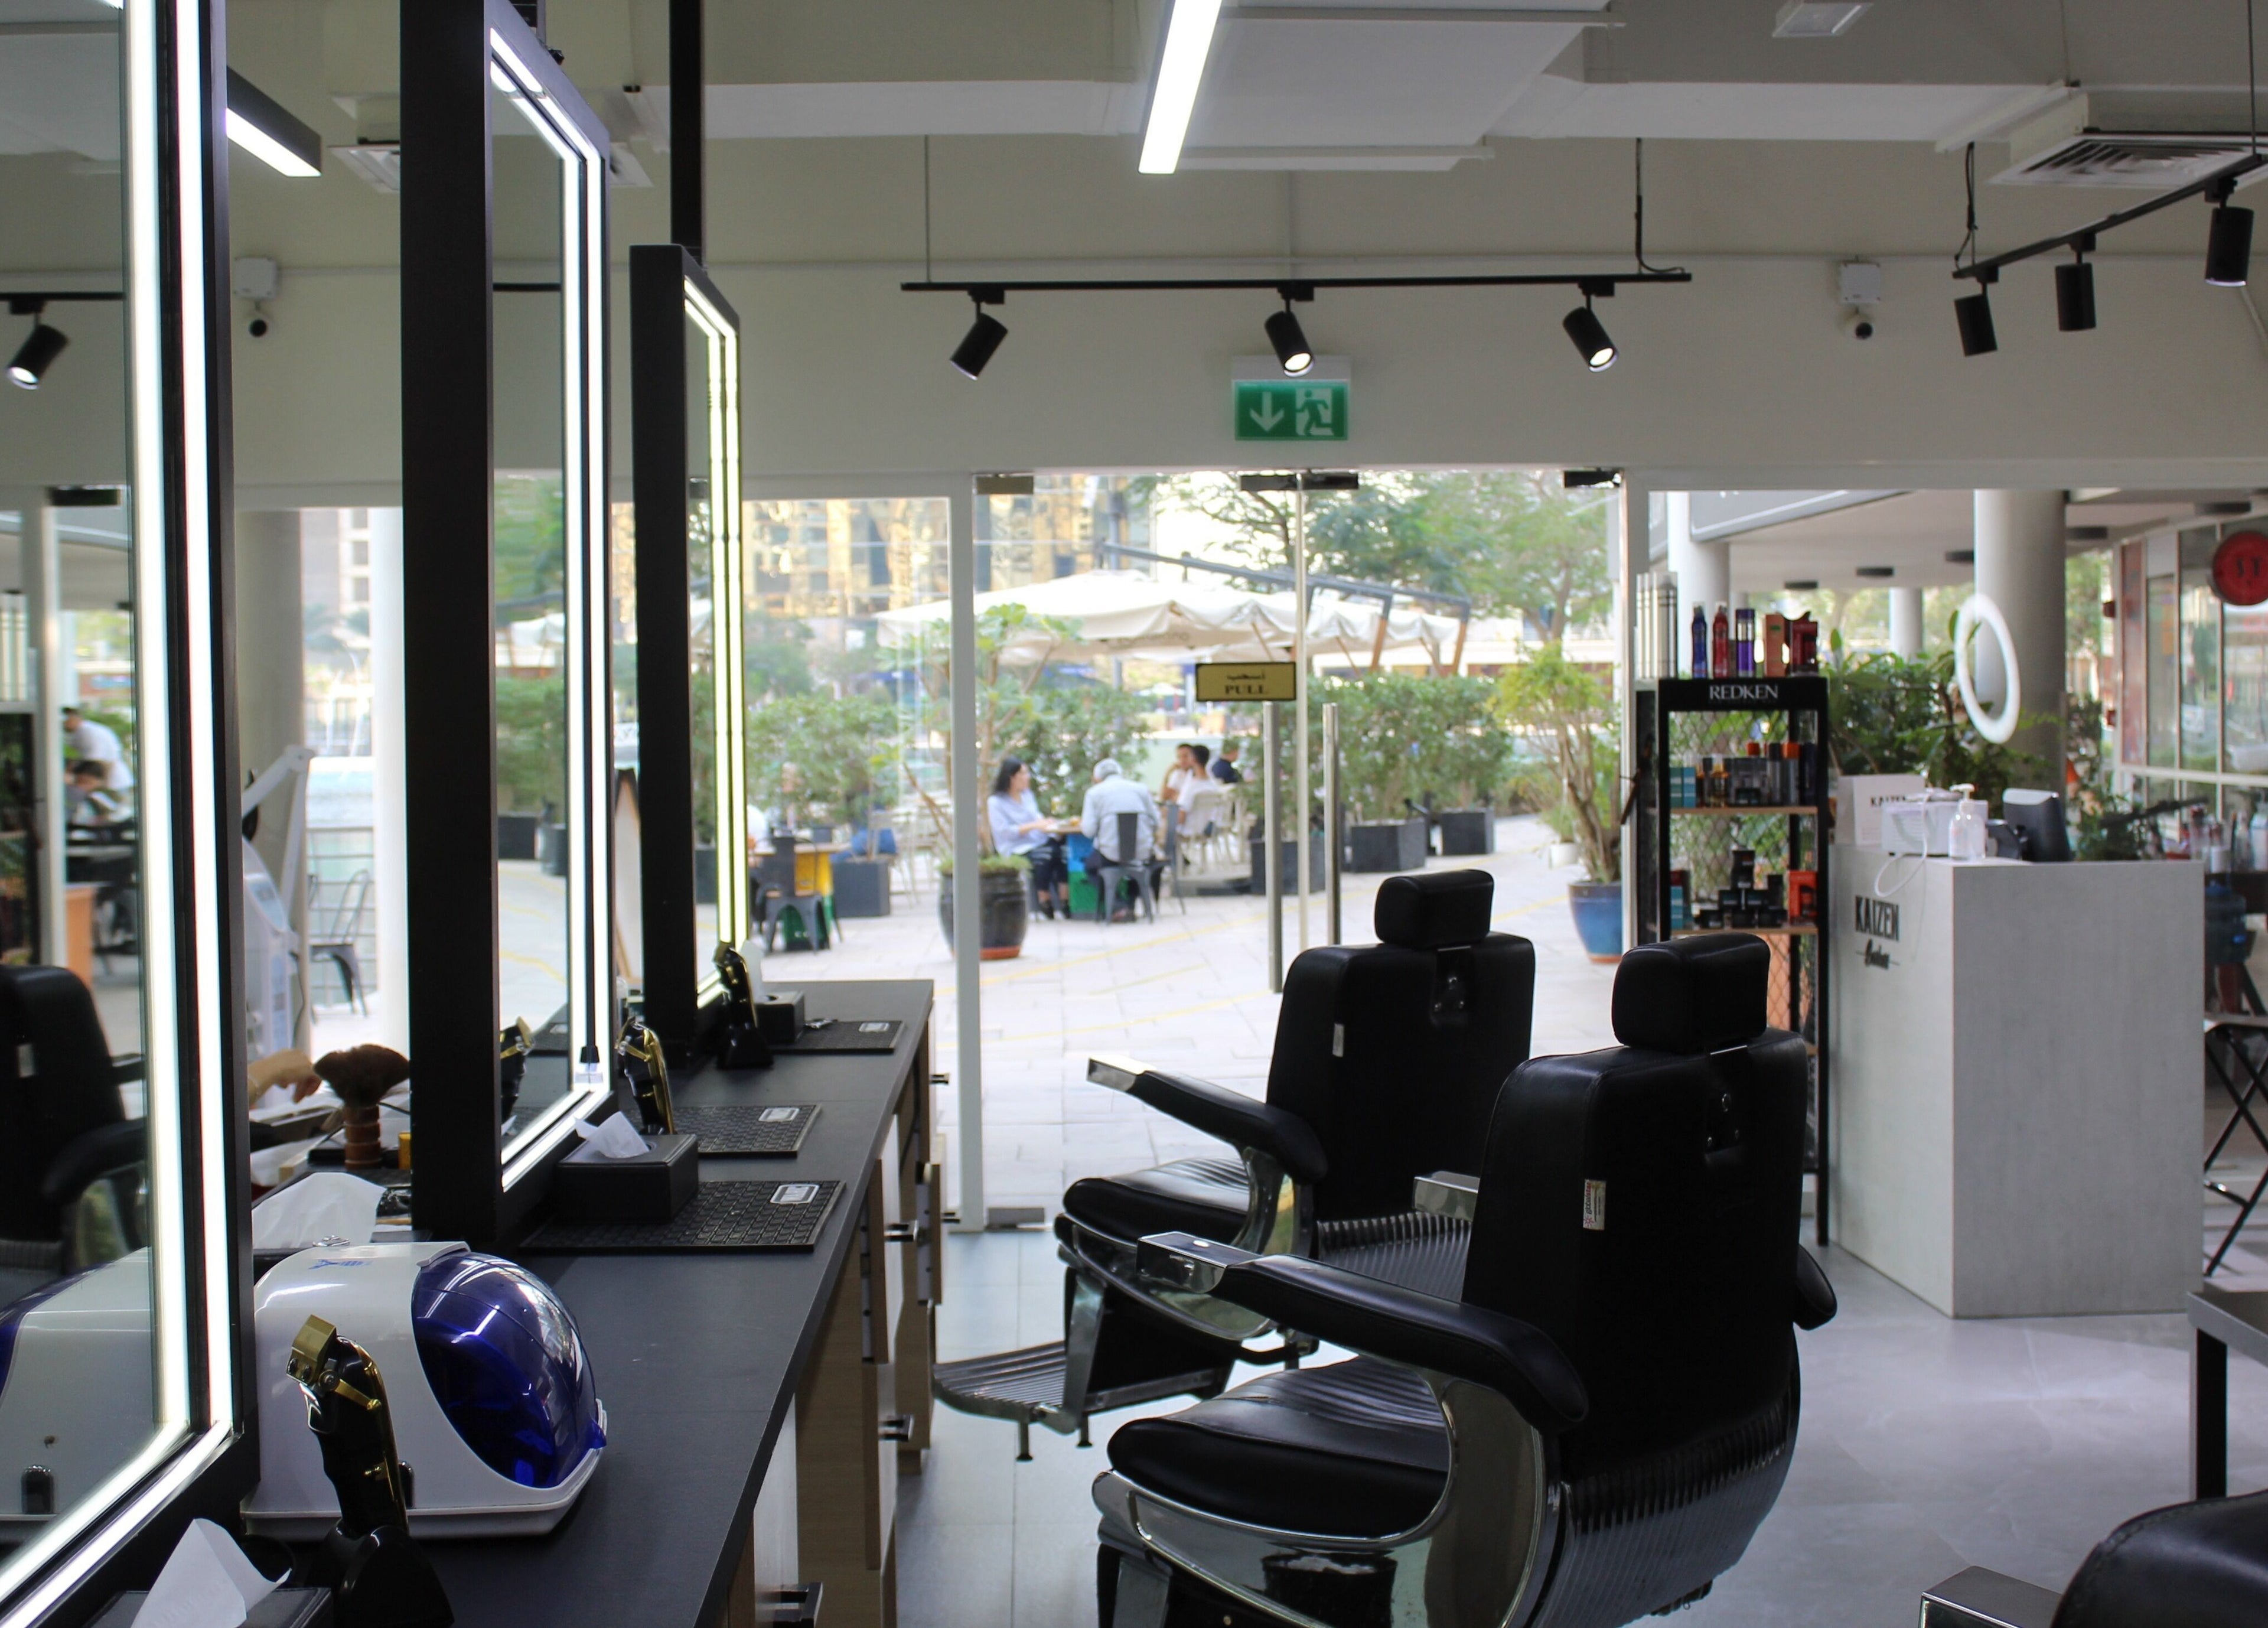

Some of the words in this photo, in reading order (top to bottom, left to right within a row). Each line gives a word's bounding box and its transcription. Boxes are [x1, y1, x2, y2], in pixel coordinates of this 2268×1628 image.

[1225, 685, 1267, 695] PULL
[1709, 683, 1778, 699] REDKEN
[1855, 896, 1899, 942] KAIZEN
